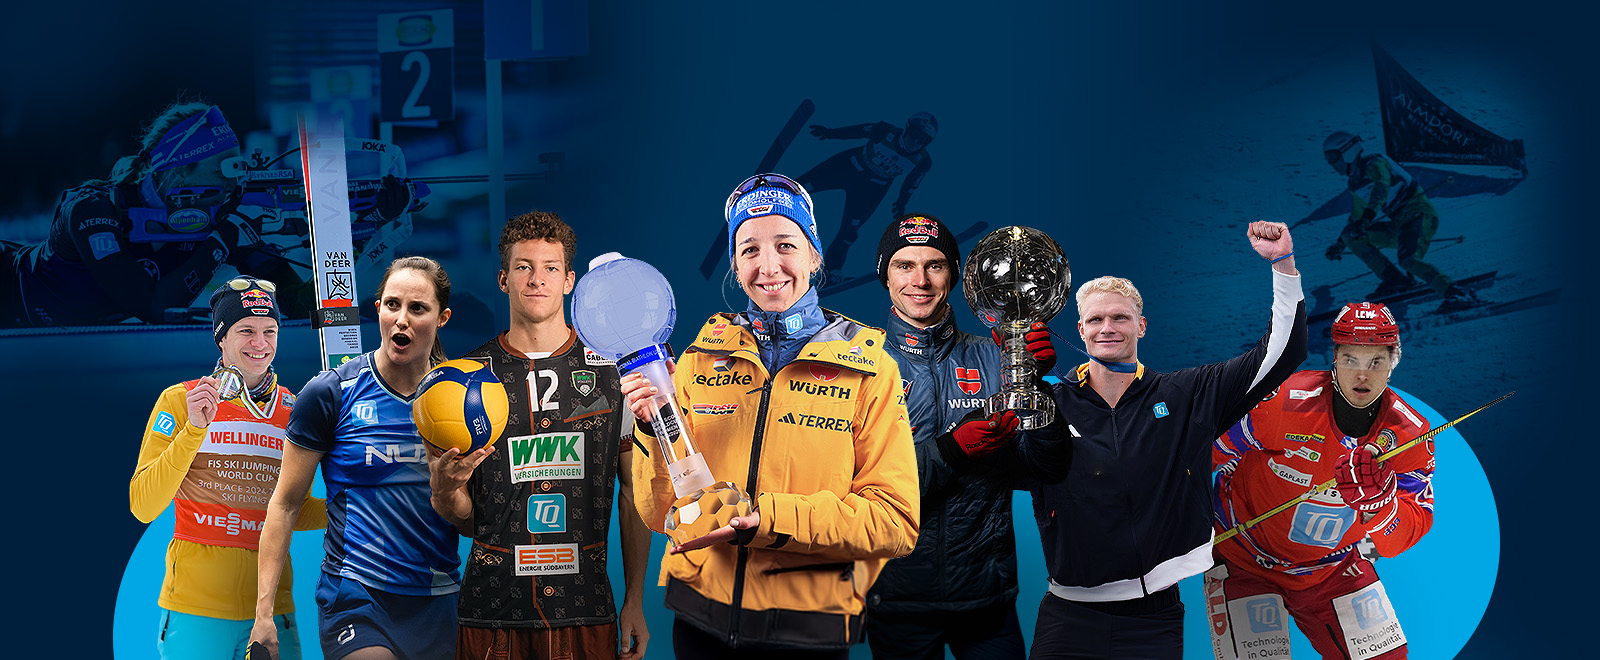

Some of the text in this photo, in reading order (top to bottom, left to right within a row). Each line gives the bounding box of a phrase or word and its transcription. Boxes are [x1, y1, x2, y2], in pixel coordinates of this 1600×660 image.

[400, 50, 431, 119] 2
[1394, 92, 1472, 147] ALMDORF
[361, 141, 386, 153] JOKA
[899, 224, 918, 237] Red
[919, 225, 938, 239] Bull
[326, 251, 347, 259] VAN
[324, 260, 351, 268] DEER
[242, 298, 259, 309] Red
[787, 319, 801, 330] TQ
[837, 352, 875, 367] tectake
[525, 369, 560, 413] 12
[789, 379, 851, 400] WÜRTH
[947, 398, 986, 410] WÜRT
[1155, 405, 1167, 415] TQ
[354, 403, 374, 422] TQ
[159, 414, 174, 433] TQ
[799, 413, 854, 433] TERREX
[210, 431, 285, 452] WELLINGER
[1285, 434, 1310, 442] EDEKA
[365, 443, 428, 465] NU
[511, 435, 581, 467] WWK
[207, 459, 282, 475] FIS SKI JUMPING
[514, 467, 582, 480] VERSICHERUNGEN
[217, 470, 275, 482] WORLD CUP
[1279, 470, 1309, 485] GAPLAST
[198, 480, 212, 489] 3rd
[214, 482, 243, 492] PLACE
[221, 493, 267, 504] SKI FLYING
[533, 500, 561, 528] TQ
[1306, 511, 1344, 544] TQ
[519, 547, 575, 565] ESB
[543, 563, 575, 571] SÜDBAYERN
[1251, 602, 1279, 628] TQ
[1357, 594, 1386, 620] TQ
[1351, 622, 1400, 647] Technologie
[1357, 633, 1402, 656] in Qualität
[1247, 650, 1256, 659] in
